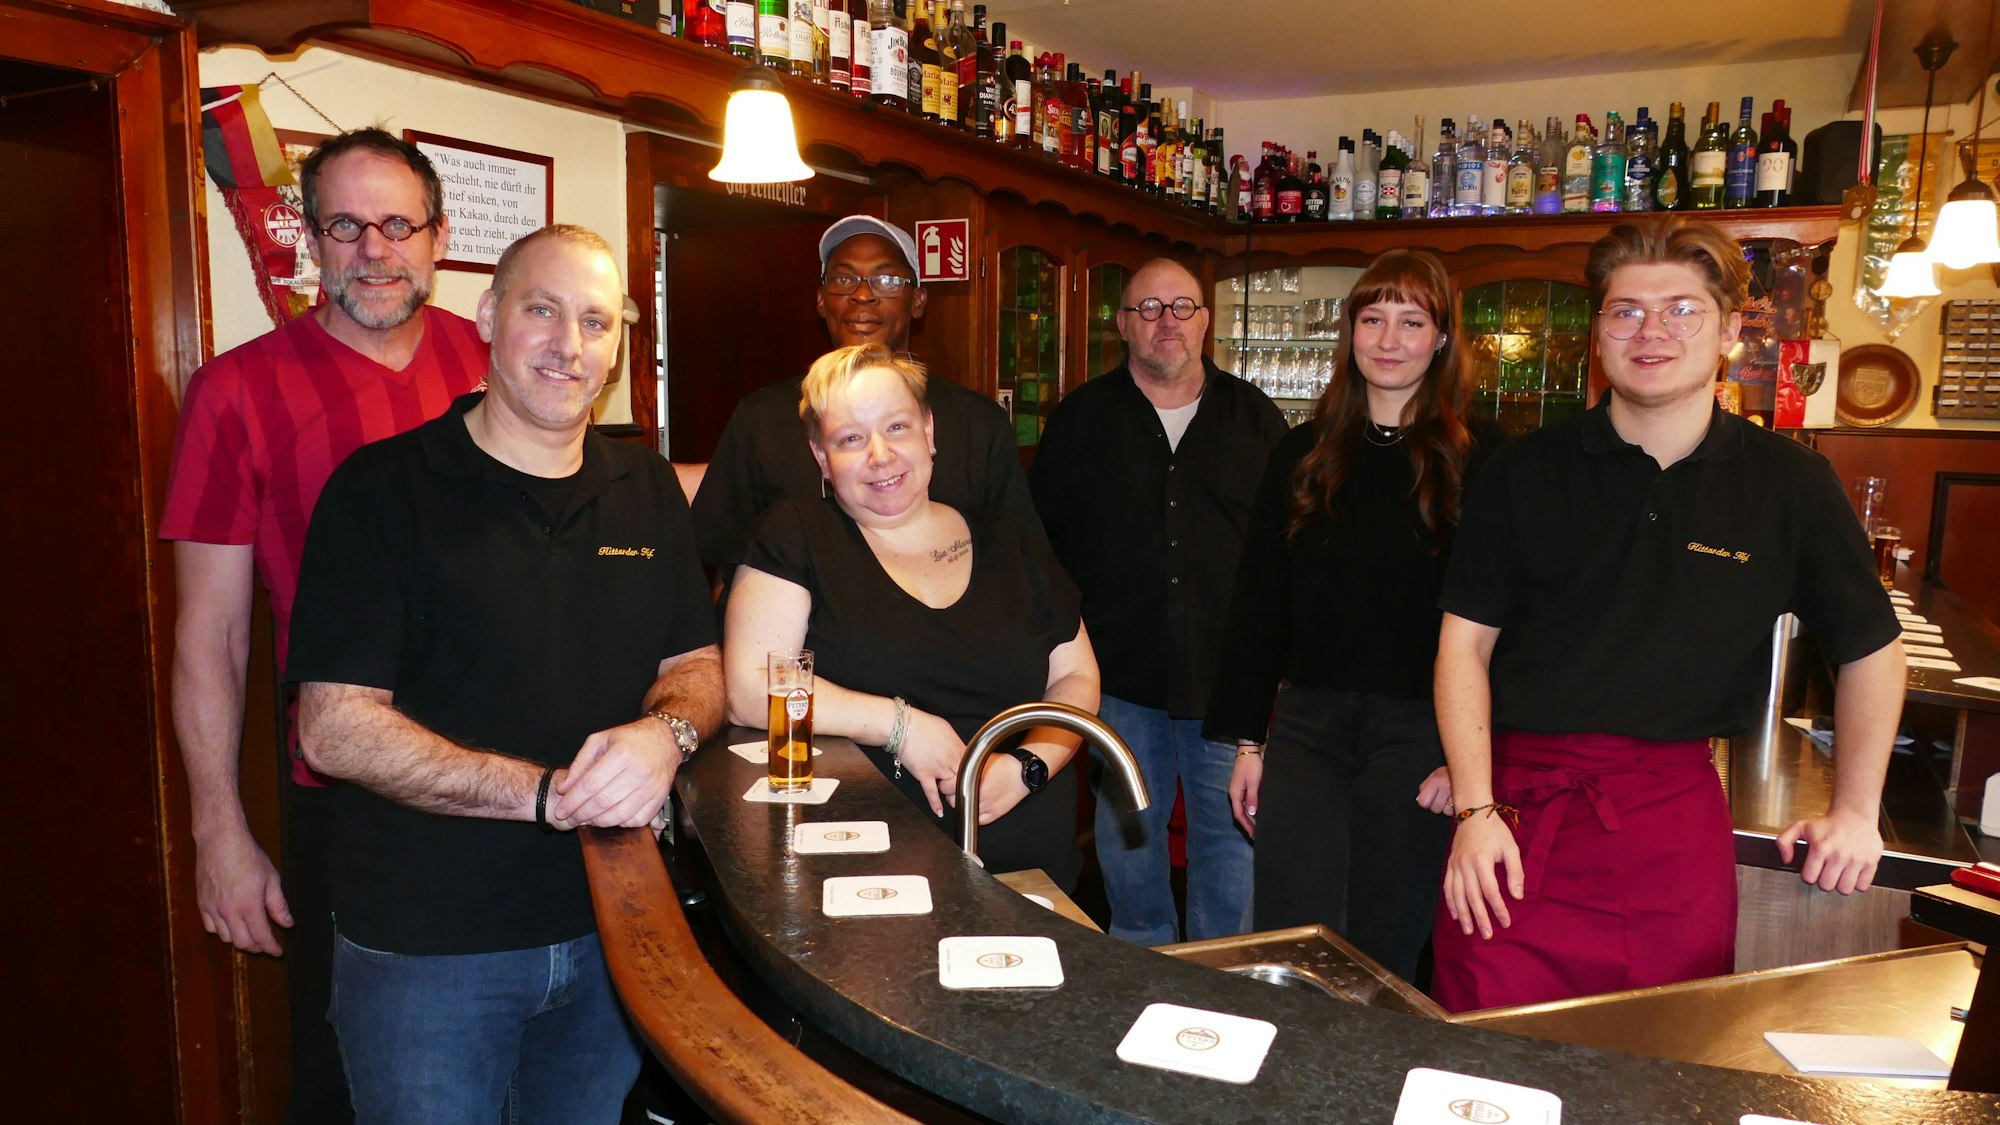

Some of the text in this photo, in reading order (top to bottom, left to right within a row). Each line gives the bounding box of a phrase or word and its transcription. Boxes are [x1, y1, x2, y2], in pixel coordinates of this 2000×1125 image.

[434, 152, 517, 176] "Was auch immer
[484, 178, 499, 190] nie
[500, 181, 522, 193] dürft
[524, 183, 537, 195] ihr
[1511, 187, 1528, 196] Korn
[449, 190, 466, 202] tief
[467, 193, 500, 207] sinken,
[502, 199, 518, 209] von
[442, 206, 537, 227] em Kakao, durch den
[459, 224, 481, 237] euch
[483, 227, 508, 241] zieht,
[462, 243, 473, 253] zu
